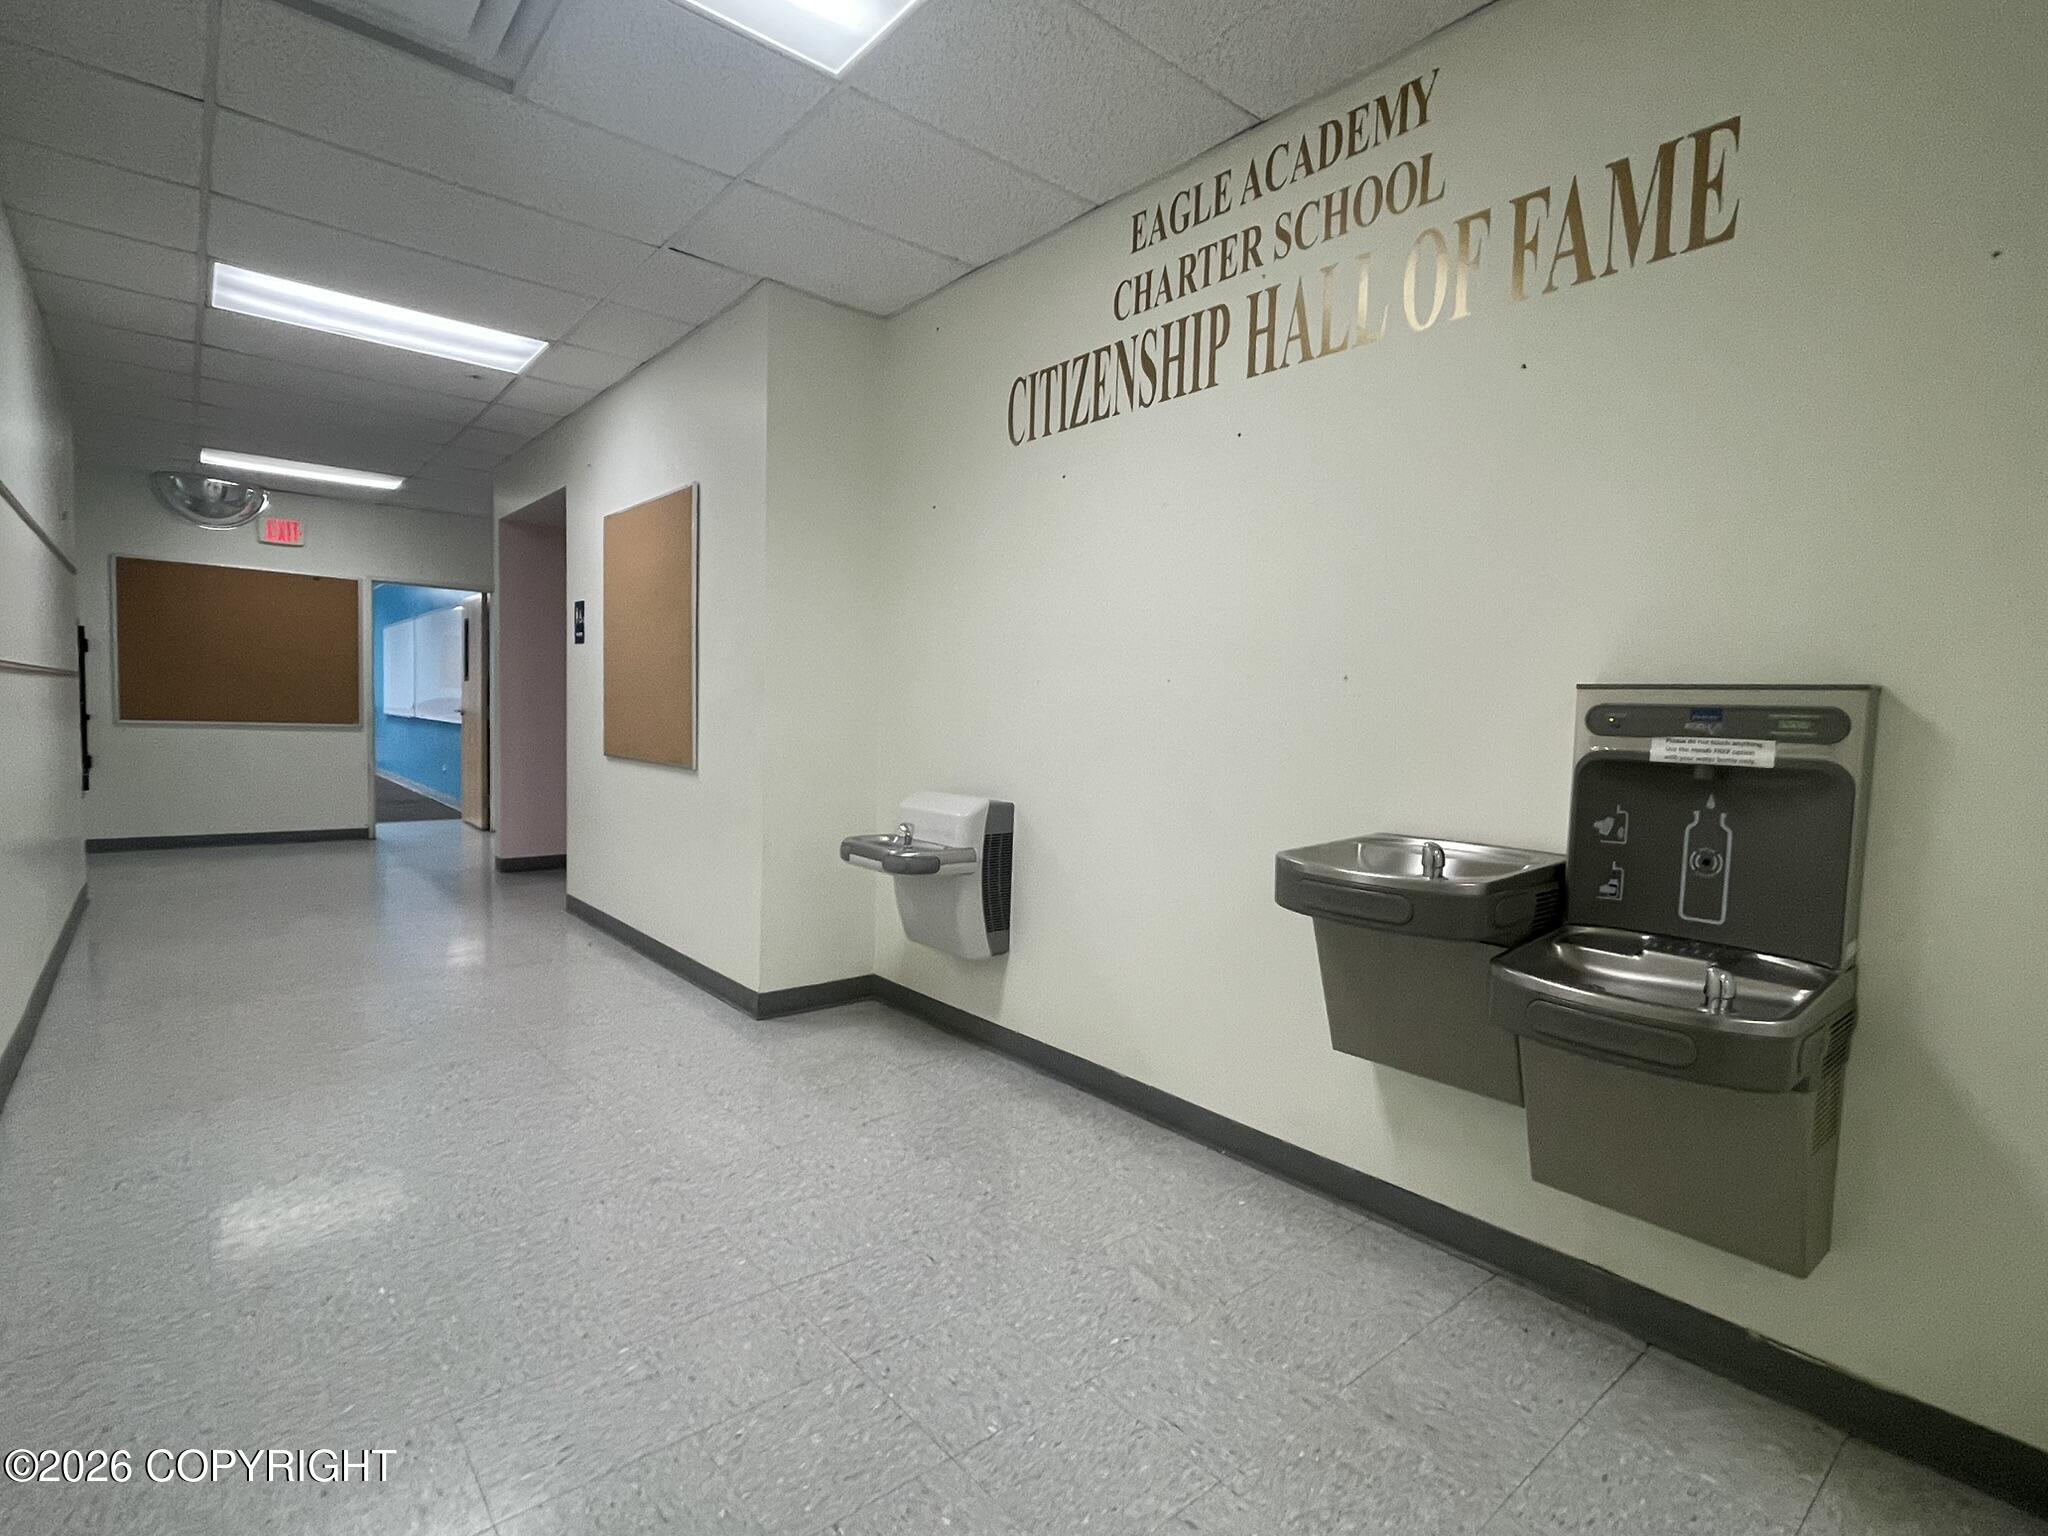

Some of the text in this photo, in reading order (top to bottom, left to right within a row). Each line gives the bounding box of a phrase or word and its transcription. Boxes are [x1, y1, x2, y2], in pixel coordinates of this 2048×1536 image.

[1114, 152, 1446, 321] CHARTER SCHOOL
[1131, 68, 1440, 254] EAGLE ACADEMY
[1007, 115, 1741, 447] CITIZENSHIP HALL OF FAME
[265, 519, 300, 544] EXIT
